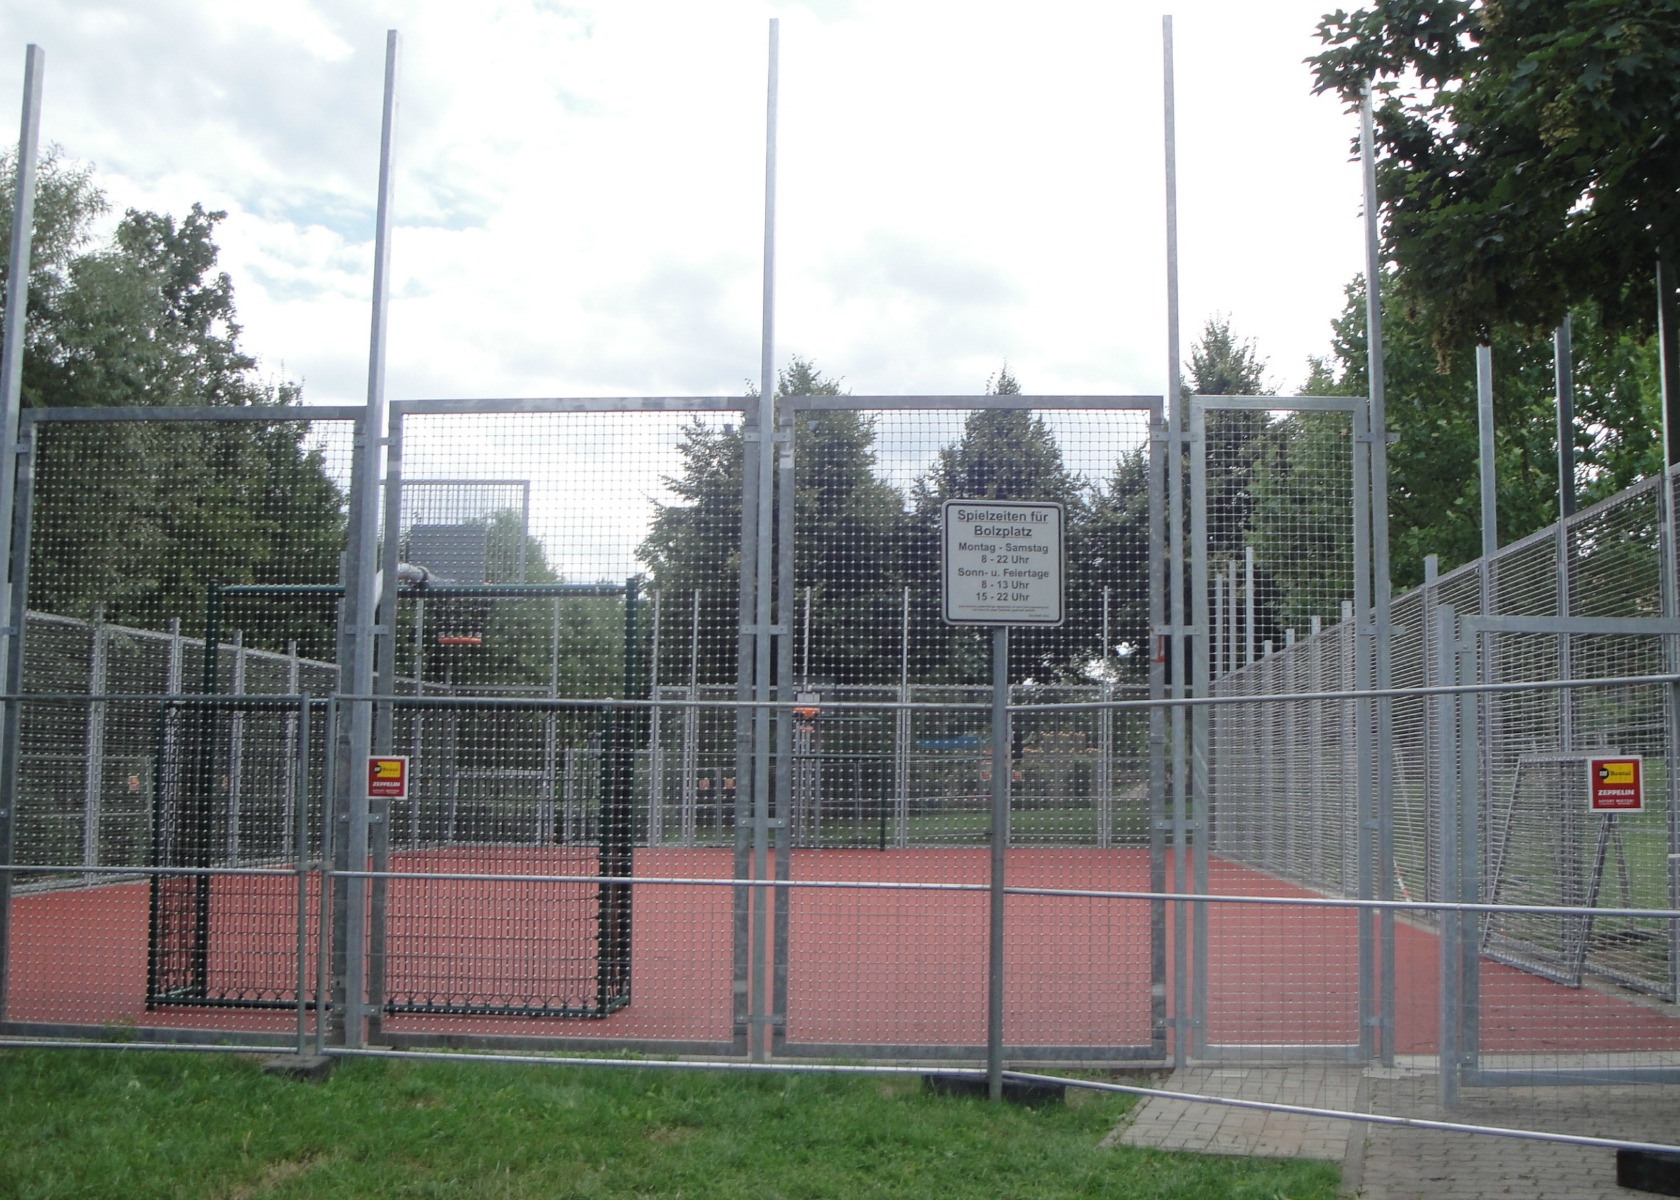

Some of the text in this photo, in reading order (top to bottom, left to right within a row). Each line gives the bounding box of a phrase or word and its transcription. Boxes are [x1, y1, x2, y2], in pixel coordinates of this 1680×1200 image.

[958, 510, 1048, 522] Spielzeiten für
[974, 525, 1032, 538] Bolzplatz
[959, 542, 995, 553] Montag
[1006, 543, 1048, 554] Samstag
[981, 555, 987, 563] 8
[997, 555, 1008, 563] 22
[1012, 556, 1030, 564] Uhr
[958, 568, 988, 576] Sonn-
[1004, 569, 1049, 579] Feiertage
[981, 580, 987, 588] 8
[1012, 581, 1030, 589] Uhr
[997, 593, 1008, 601] 22
[1012, 593, 1030, 601] Uhr
